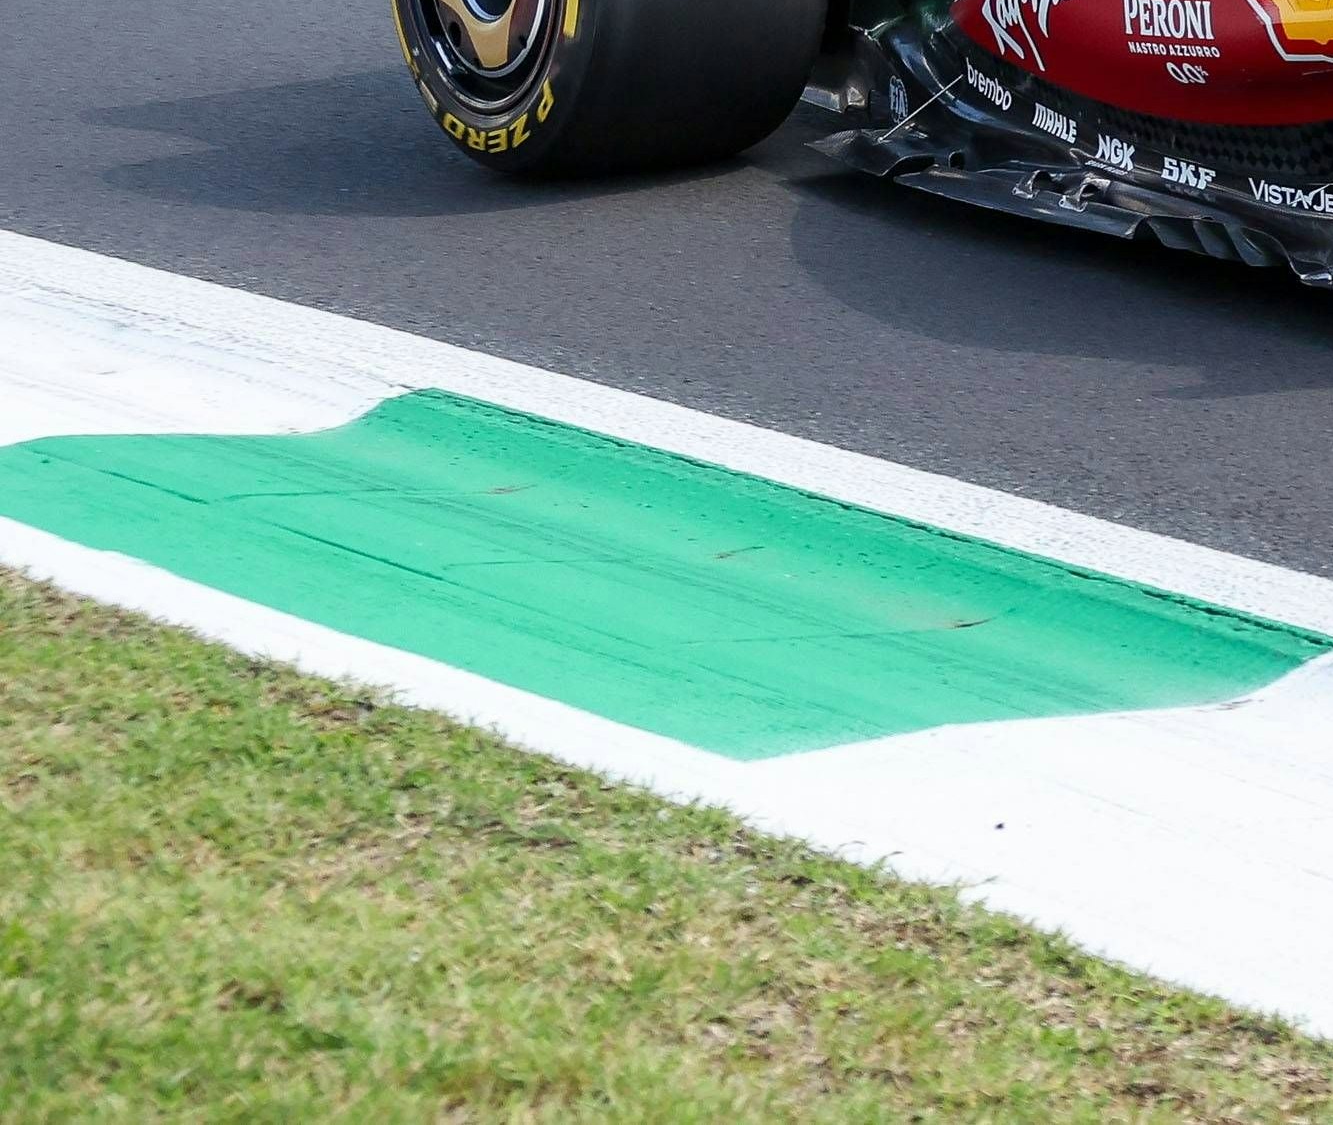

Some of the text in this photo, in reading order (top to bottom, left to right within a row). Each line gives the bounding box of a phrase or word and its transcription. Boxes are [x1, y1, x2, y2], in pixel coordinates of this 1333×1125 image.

[1127, 41, 1221, 59] NASTRO AZZURRO
[965, 57, 1013, 111] brembo
[1031, 102, 1078, 144] MAHLE
[1095, 134, 1136, 171] NGK
[1161, 156, 1217, 190] SKF
